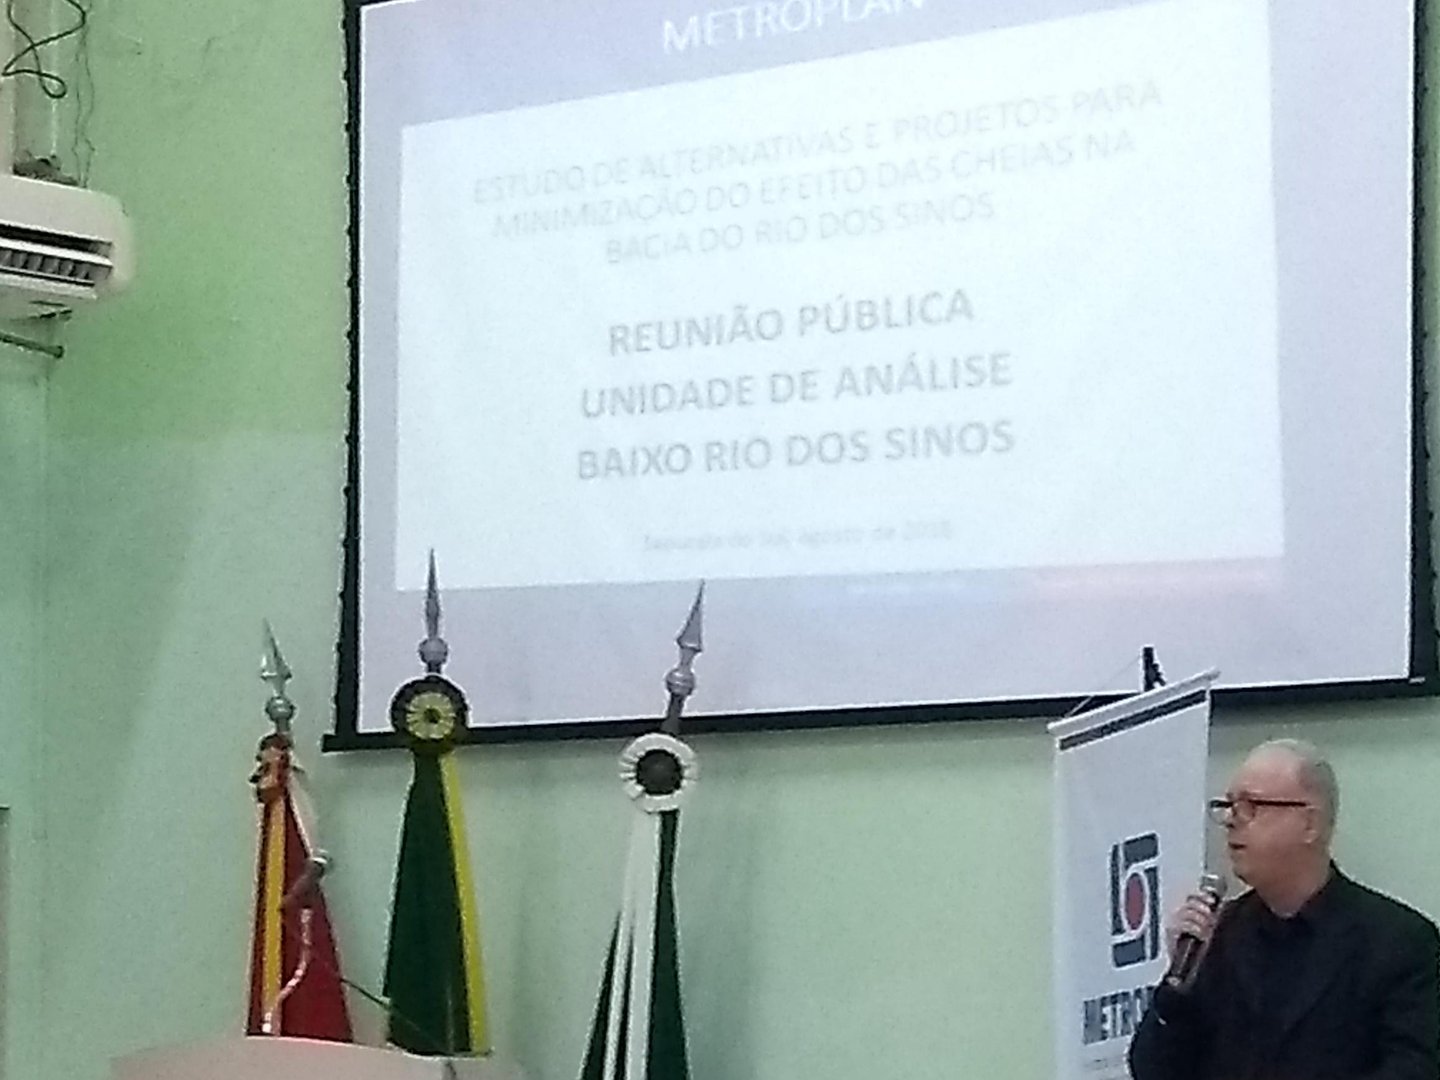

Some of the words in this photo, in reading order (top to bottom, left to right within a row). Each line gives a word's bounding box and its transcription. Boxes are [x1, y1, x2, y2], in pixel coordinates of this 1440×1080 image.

[474, 166, 584, 203] ESTUDO
[593, 157, 629, 187] DE
[639, 126, 854, 179] ALTERNATIVAS
[865, 122, 881, 150] E
[894, 96, 1059, 143] PROJETOS
[1071, 79, 1163, 115] PARA
[705, 181, 750, 212] DO
[760, 164, 867, 204] EFEITO
[877, 155, 942, 188] DAS
[950, 135, 1074, 179] CHEIAS
[1084, 128, 1137, 160] NA
[605, 231, 692, 264] BACIA
[700, 223, 744, 252] DO
[755, 215, 808, 244] RIO
[818, 205, 885, 240] DOS
[895, 191, 996, 231] SINOS
[609, 304, 784, 356] REUNIÃO
[799, 288, 975, 337] PÚBLICA
[582, 375, 755, 418] UNIDADE
[769, 370, 821, 403] DE
[833, 351, 1014, 399] ANÁLISE
[578, 443, 692, 480] BAIXO
[704, 437, 772, 473] RIO
[785, 430, 871, 466] DOS
[884, 420, 1016, 460] SINOS
